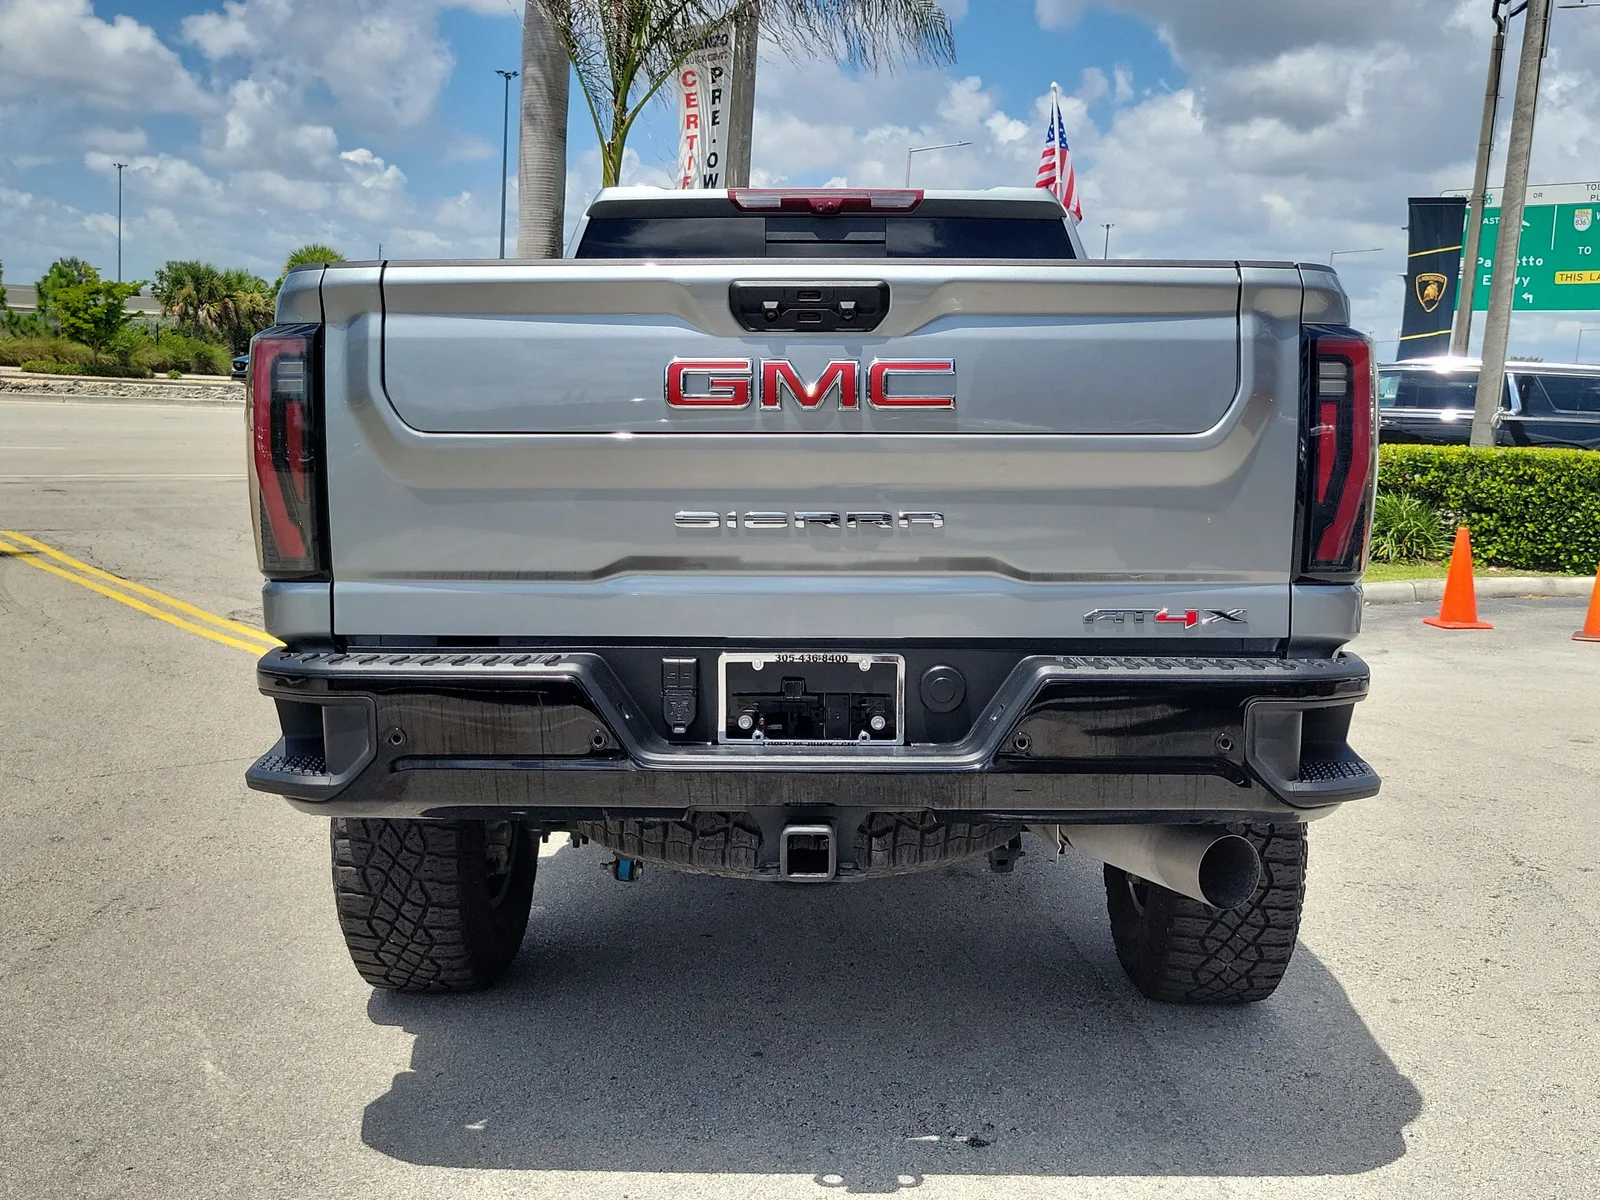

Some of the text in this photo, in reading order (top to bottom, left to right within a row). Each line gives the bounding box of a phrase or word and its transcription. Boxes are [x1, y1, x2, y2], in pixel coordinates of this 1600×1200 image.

[1482, 217, 1500, 225] AST
[1577, 246, 1592, 255] TO
[1559, 273, 1583, 282] THIS
[664, 357, 956, 411] GMC
[674, 510, 945, 529] SIERRA
[1083, 606, 1248, 630] AT4X
[775, 654, 848, 663] 305-436-8400
